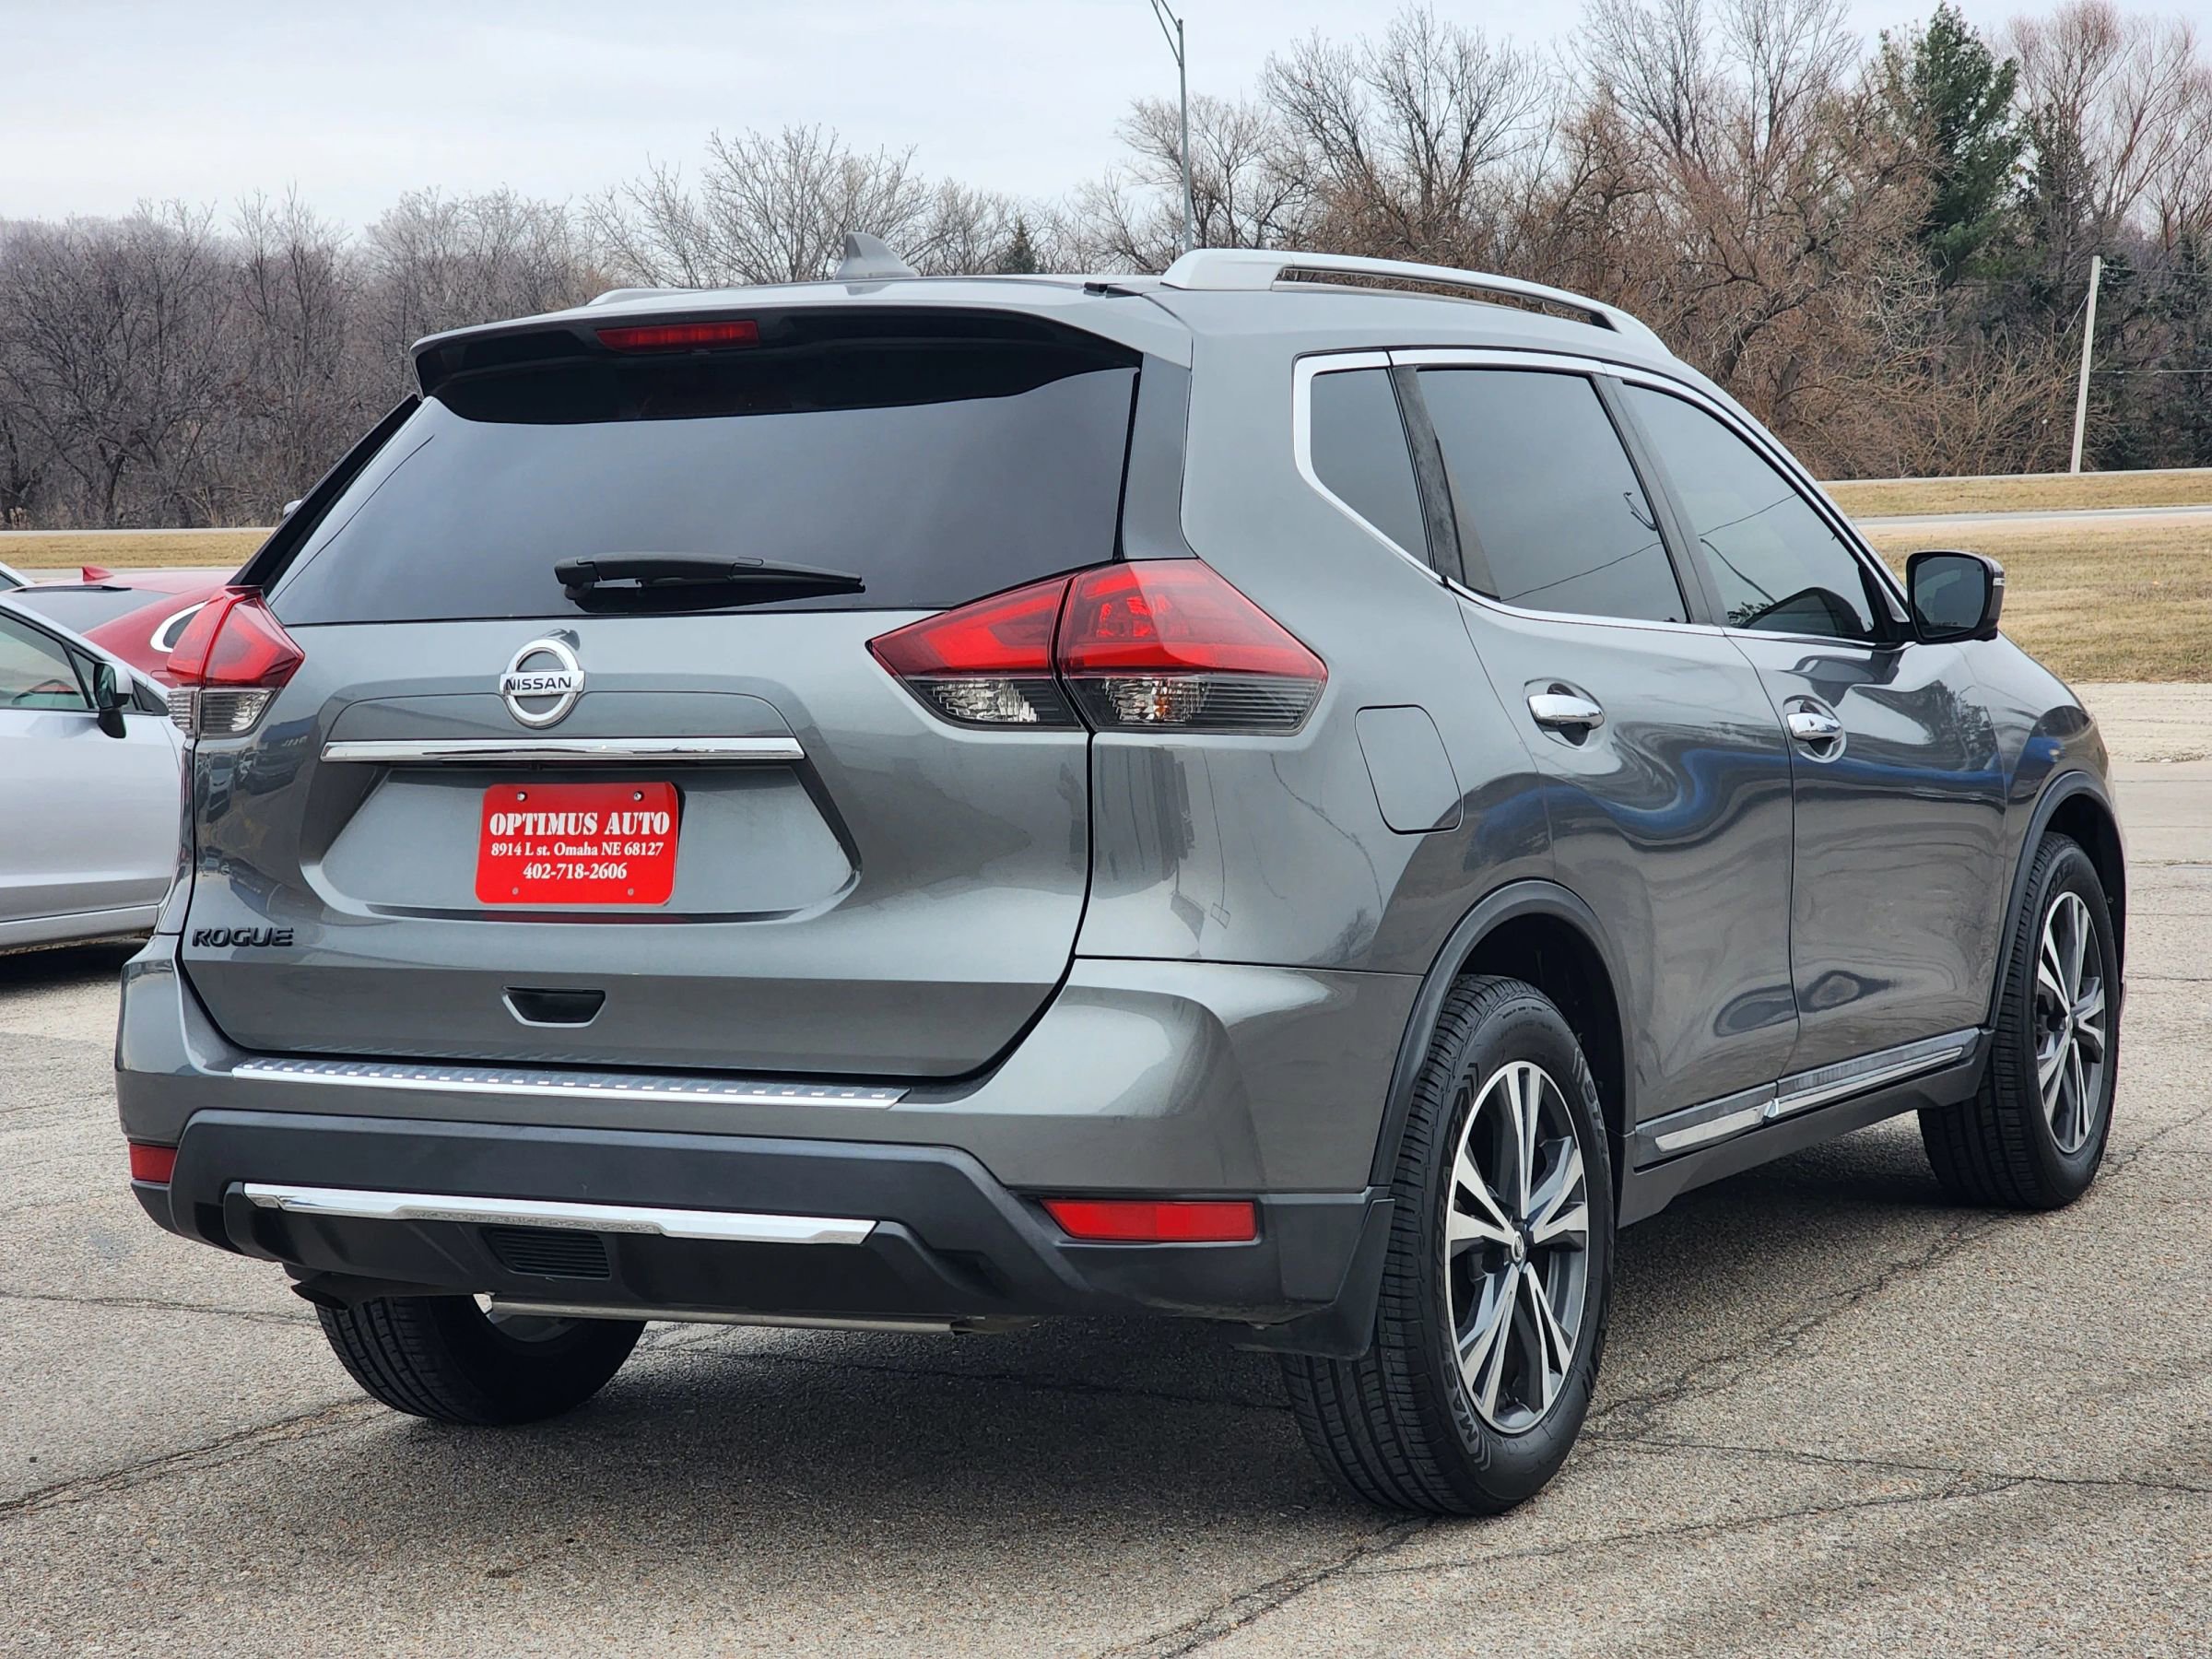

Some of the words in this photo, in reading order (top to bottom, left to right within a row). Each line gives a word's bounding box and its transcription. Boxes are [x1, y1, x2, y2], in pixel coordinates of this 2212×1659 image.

[505, 677, 571, 690] NISSAN
[489, 812, 598, 836] OPTIMUS
[604, 811, 670, 835] AUTO
[491, 841, 523, 857] 8914
[524, 841, 535, 856] L
[535, 845, 551, 856] st.
[554, 841, 598, 856] Omaha
[601, 841, 622, 856] NE
[624, 841, 665, 856] 68127
[523, 862, 628, 880] 402-718-2606
[192, 927, 294, 947] ROGUE
[1435, 1088, 1478, 1444] MASTERCRAFT
